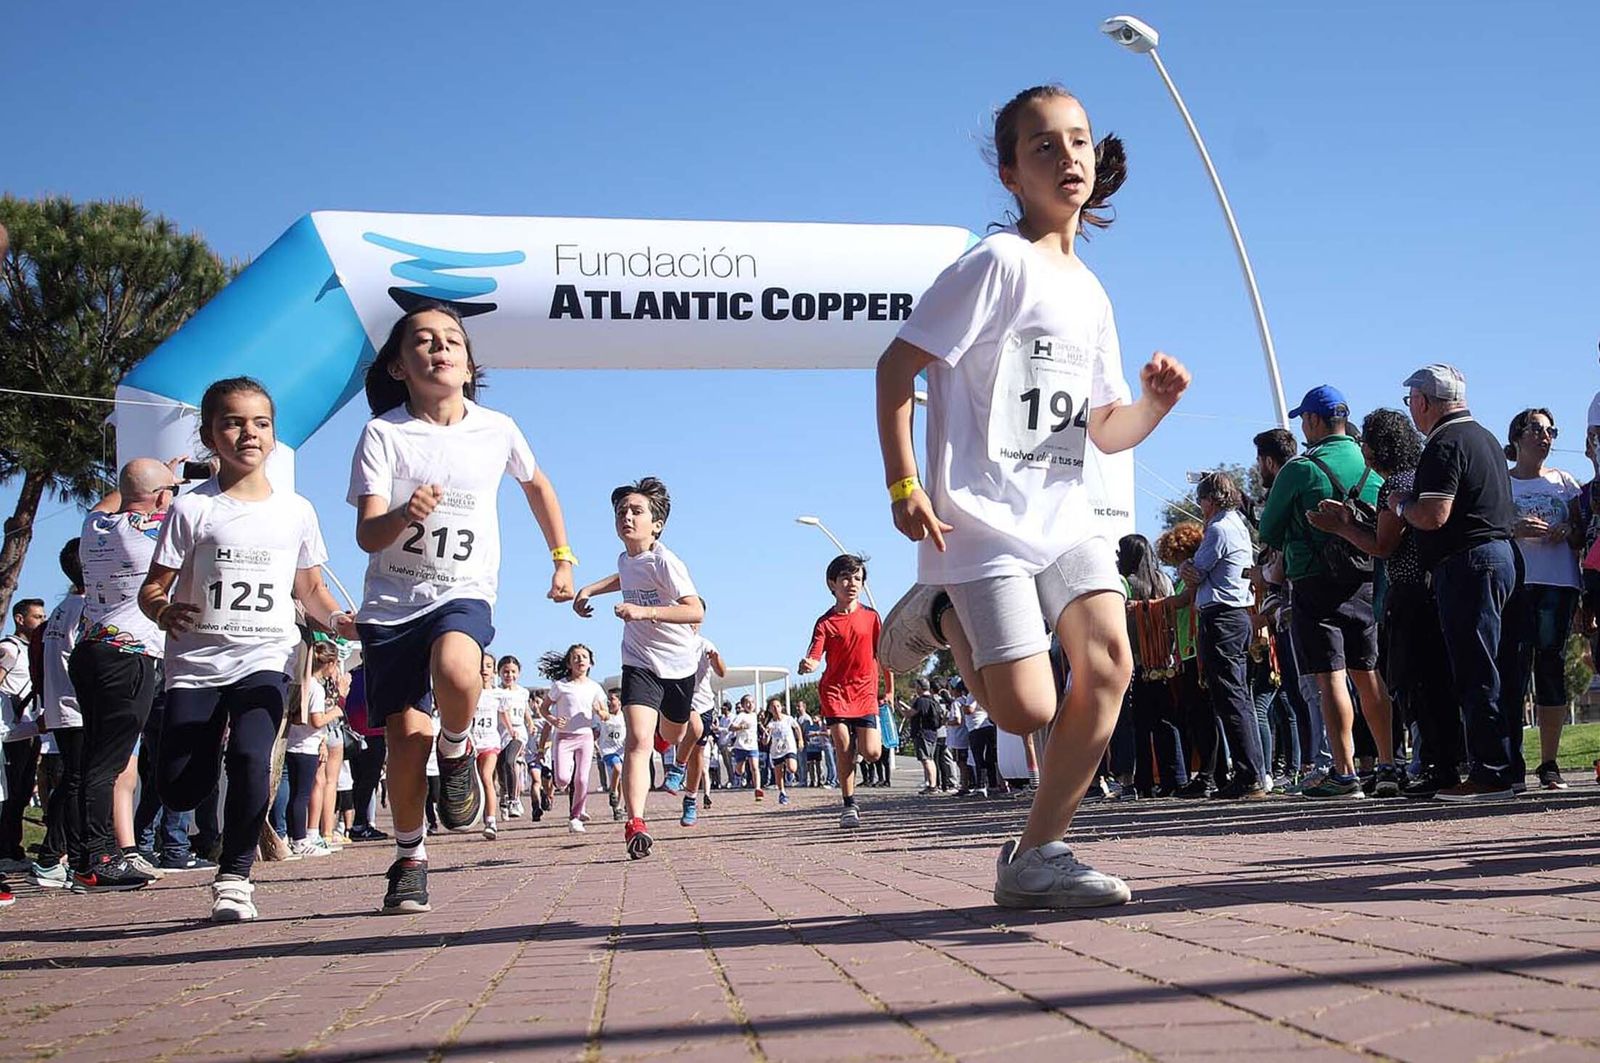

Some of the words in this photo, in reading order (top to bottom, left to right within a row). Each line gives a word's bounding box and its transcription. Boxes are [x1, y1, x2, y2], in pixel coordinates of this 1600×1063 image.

[556, 244, 756, 278] Fundación
[549, 284, 753, 320] ATLANTIC
[761, 286, 914, 321] COPPER
[1020, 387, 1089, 438] 194
[1000, 448, 1034, 461] Huelva
[402, 521, 475, 561] 213
[389, 564, 415, 576] Huelva
[208, 581, 274, 612] 125
[472, 717, 493, 729] 143
